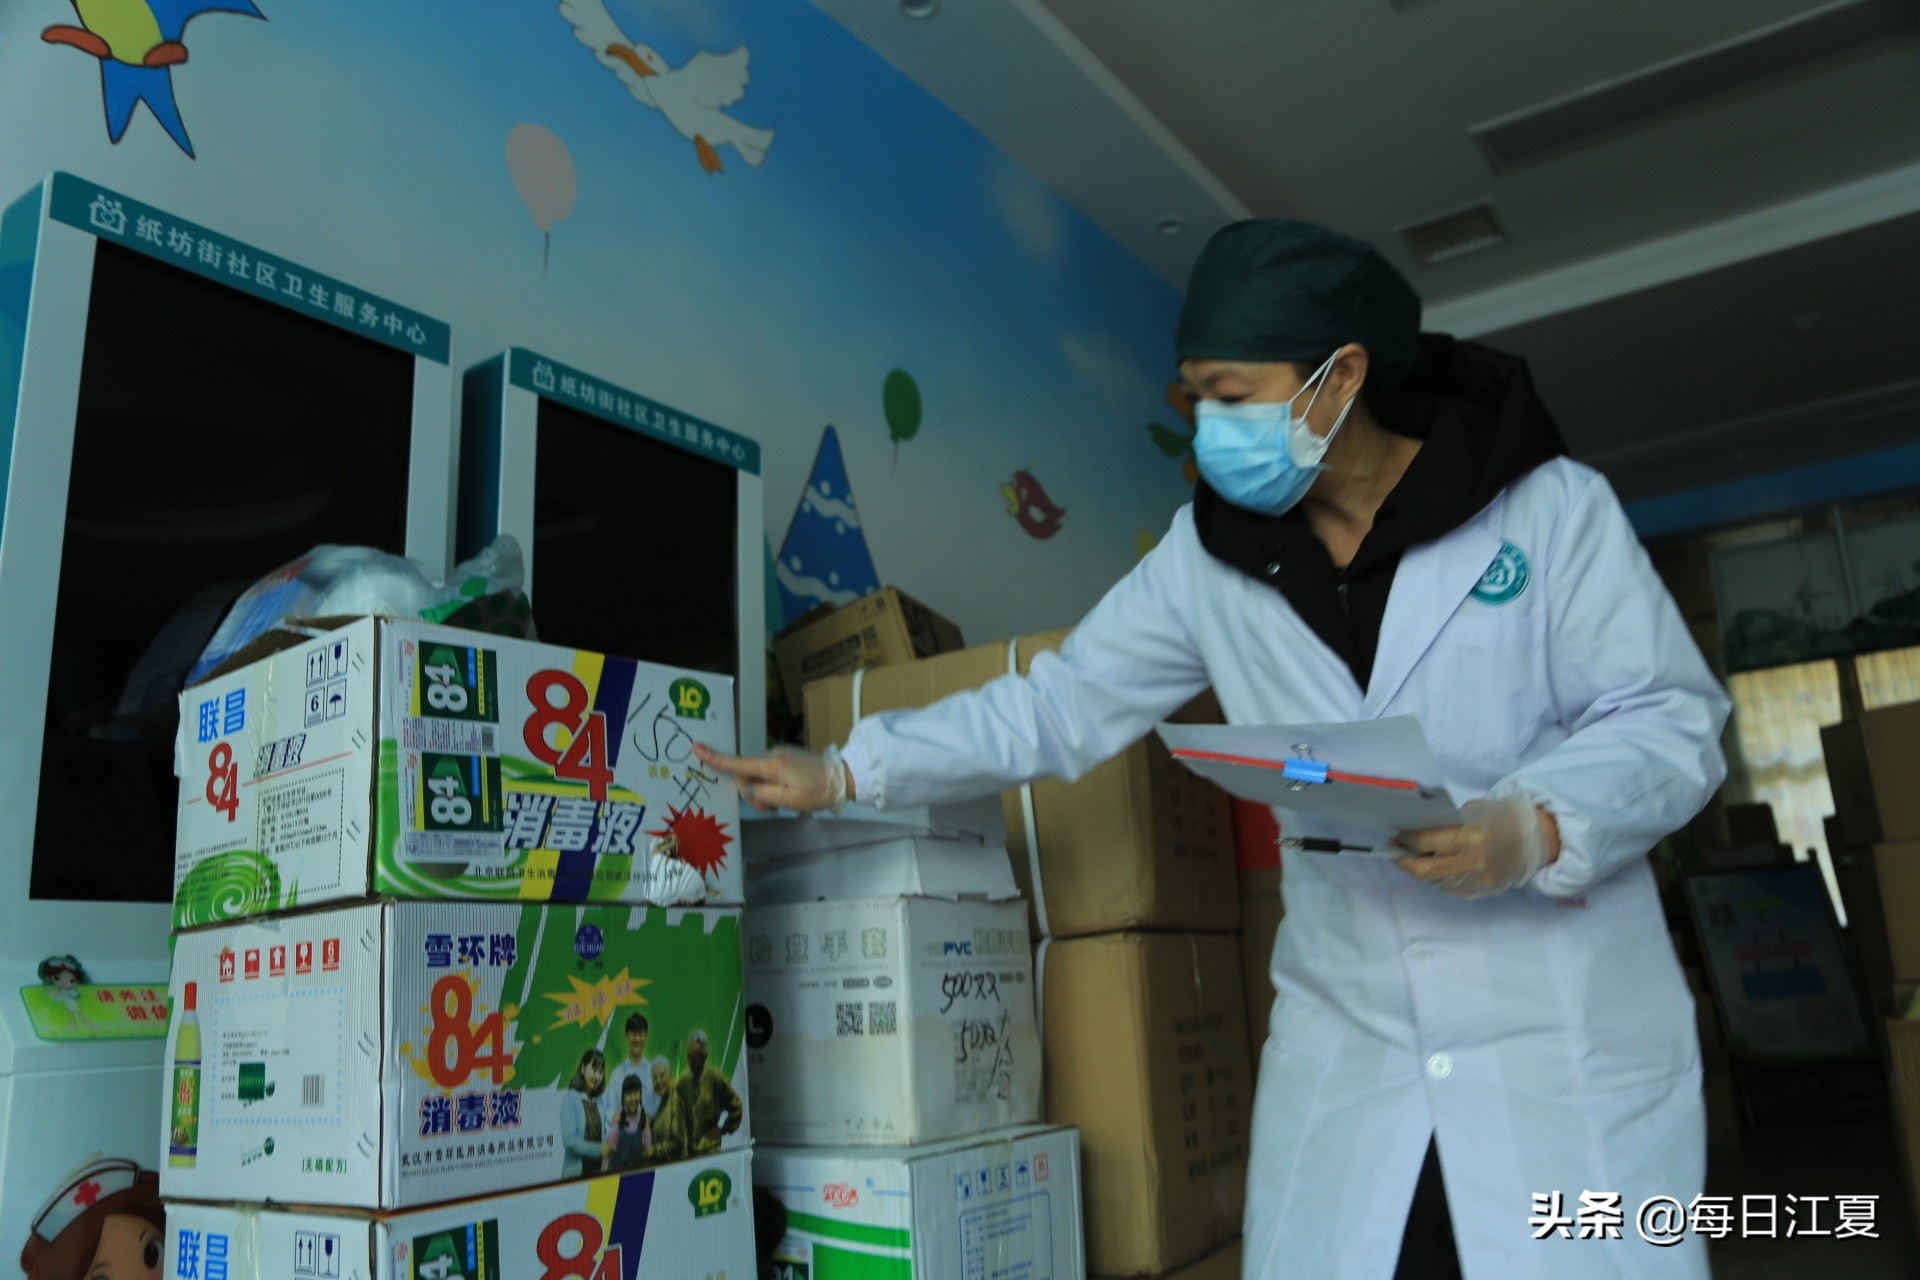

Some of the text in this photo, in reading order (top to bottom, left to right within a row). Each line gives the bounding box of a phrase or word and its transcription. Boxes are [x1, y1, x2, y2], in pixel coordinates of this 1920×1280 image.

[135, 213, 427, 346] 纸坊街社区卫生服务中心
[559, 373, 746, 462] 纸坊街社区卫生服务中心
[425, 663, 468, 713] 84
[198, 687, 246, 743] 联昌
[523, 668, 615, 801] 84
[206, 742, 240, 823] 84
[428, 776, 472, 825] 84
[502, 792, 646, 855] 消毒液
[425, 933, 517, 968] 雪环牌
[944, 941, 972, 956] PVC
[97, 989, 160, 1004] 请关注
[428, 974, 513, 1088] 84
[420, 1090, 521, 1136] 消毒液
[177, 1229, 228, 1280] 联昌
